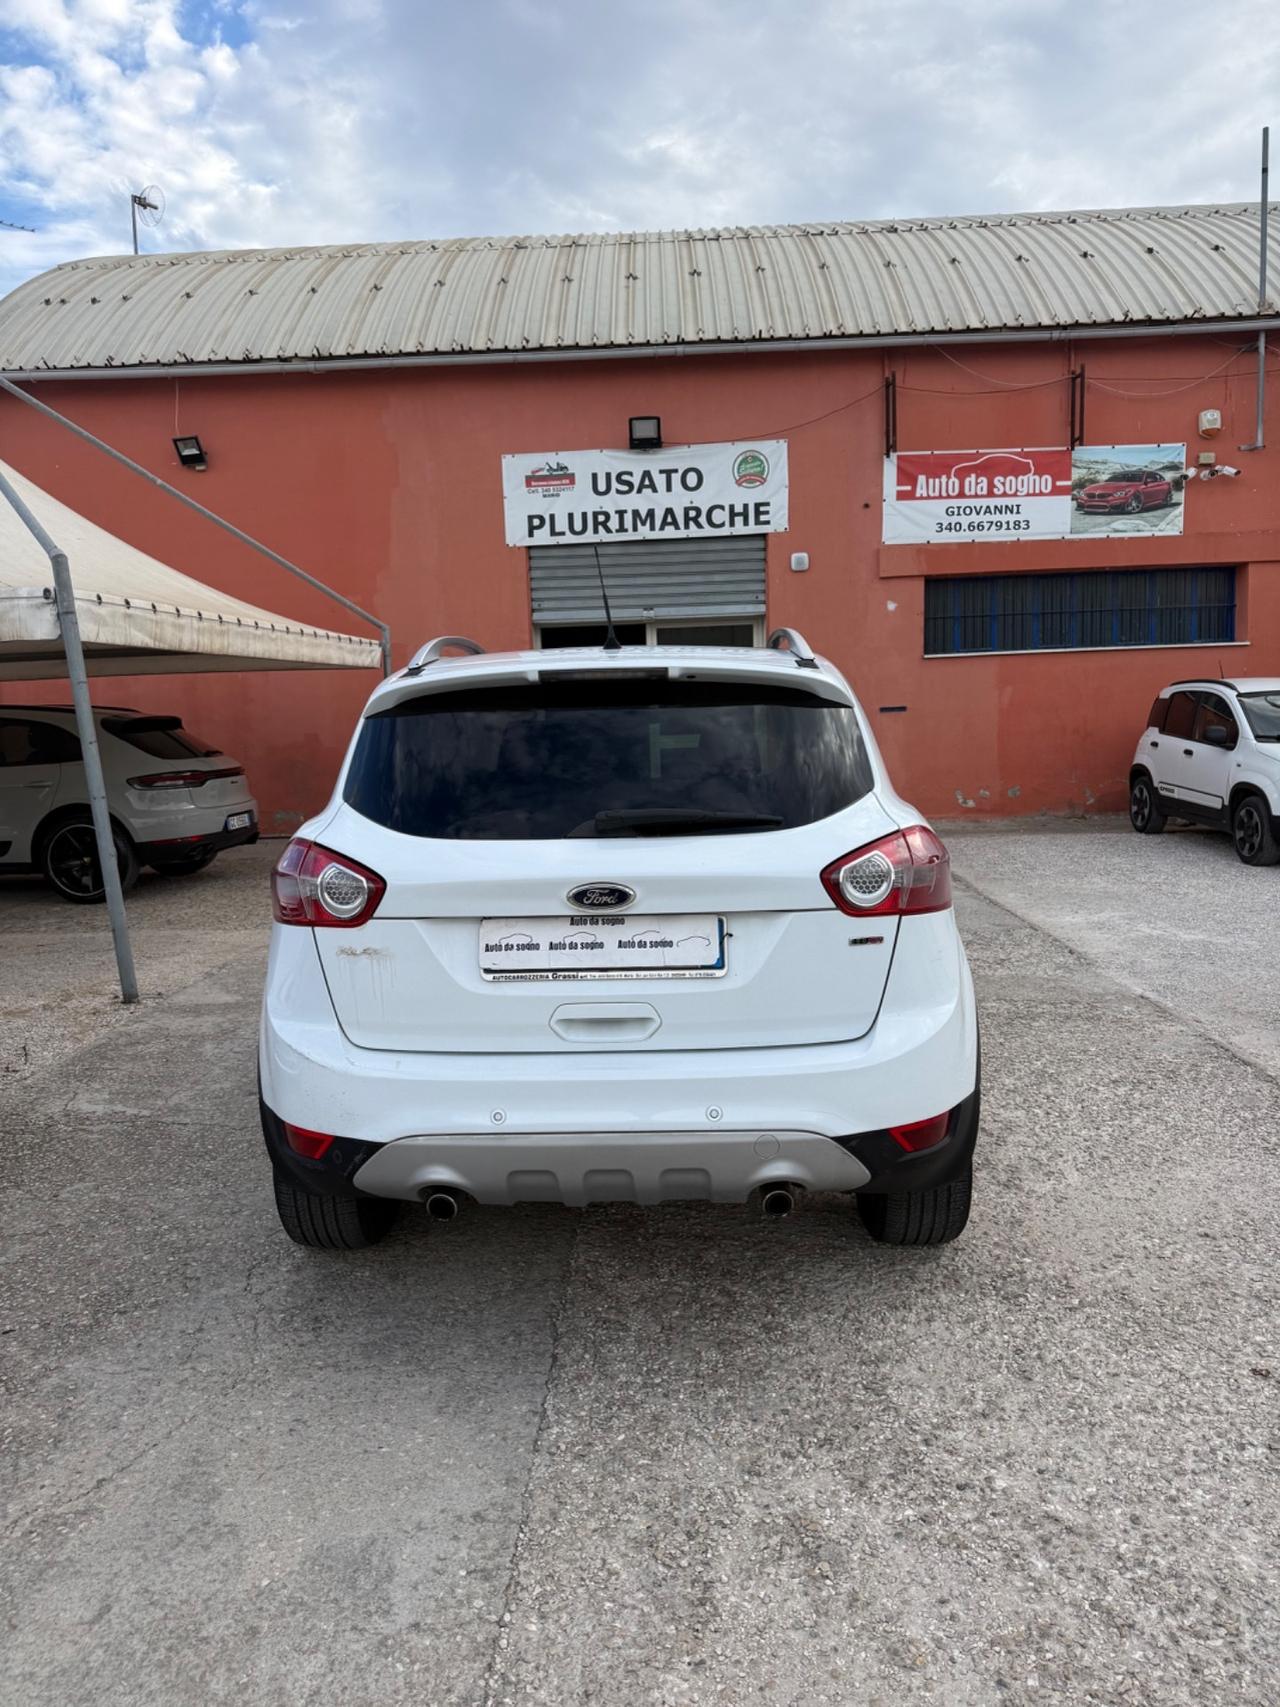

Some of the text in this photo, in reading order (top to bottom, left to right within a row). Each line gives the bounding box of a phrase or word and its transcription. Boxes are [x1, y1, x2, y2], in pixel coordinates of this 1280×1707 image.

[591, 467, 704, 496] USATO
[915, 473, 1052, 498] Auto da sogno
[945, 504, 1022, 517] GIOVANNI
[526, 502, 772, 538] PLURIMARCHE
[935, 519, 1031, 534] 340.6679183
[583, 888, 618, 906] Ford
[569, 917, 626, 927] Auto da sogno
[484, 942, 541, 953] Auto da sogno
[548, 941, 605, 951] Auto da sogno
[617, 939, 636, 949] Auto
[637, 939, 648, 949] da
[492, 973, 550, 981] AUTOCARROZZERIA
[551, 972, 579, 980] Grassi
